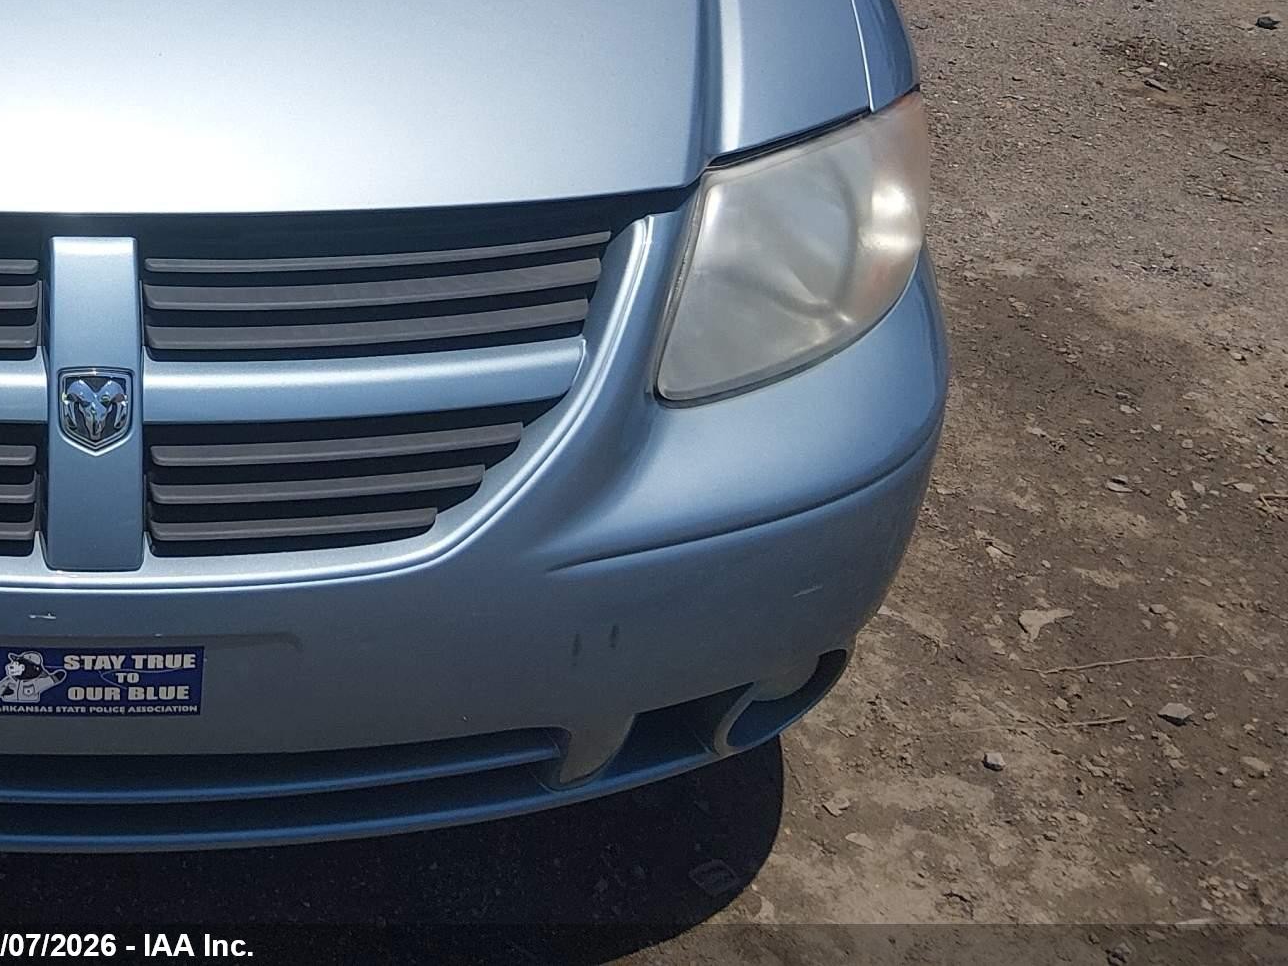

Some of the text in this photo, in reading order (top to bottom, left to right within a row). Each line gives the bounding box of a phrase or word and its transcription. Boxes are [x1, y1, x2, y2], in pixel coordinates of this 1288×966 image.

[63, 653, 196, 671] STAY TRUE
[115, 672, 140, 684] TO
[67, 686, 190, 701] OUR BLUE
[55, 705, 86, 714] STATE
[89, 706, 125, 714] POLICE
[127, 705, 198, 714] ASSOCIATION
